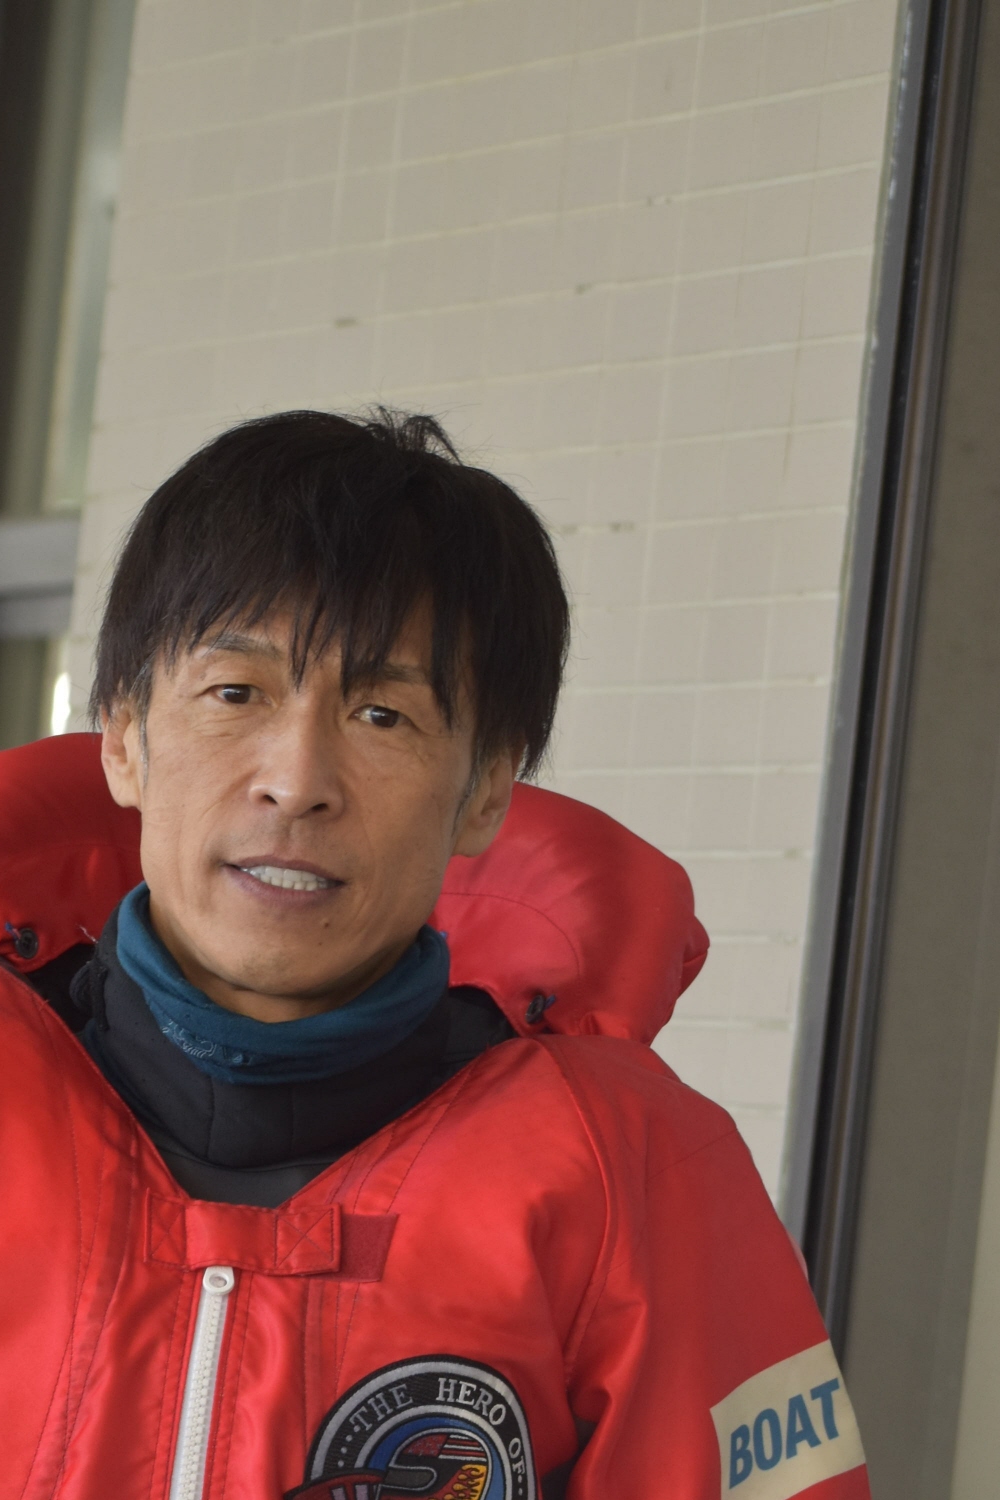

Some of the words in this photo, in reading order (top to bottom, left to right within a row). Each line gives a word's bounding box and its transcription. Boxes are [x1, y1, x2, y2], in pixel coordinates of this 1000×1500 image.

[349, 1383, 414, 1434] THE
[435, 1377, 507, 1426] HERO
[508, 1437, 526, 1475] OF
[728, 1376, 840, 1490] BOAT
